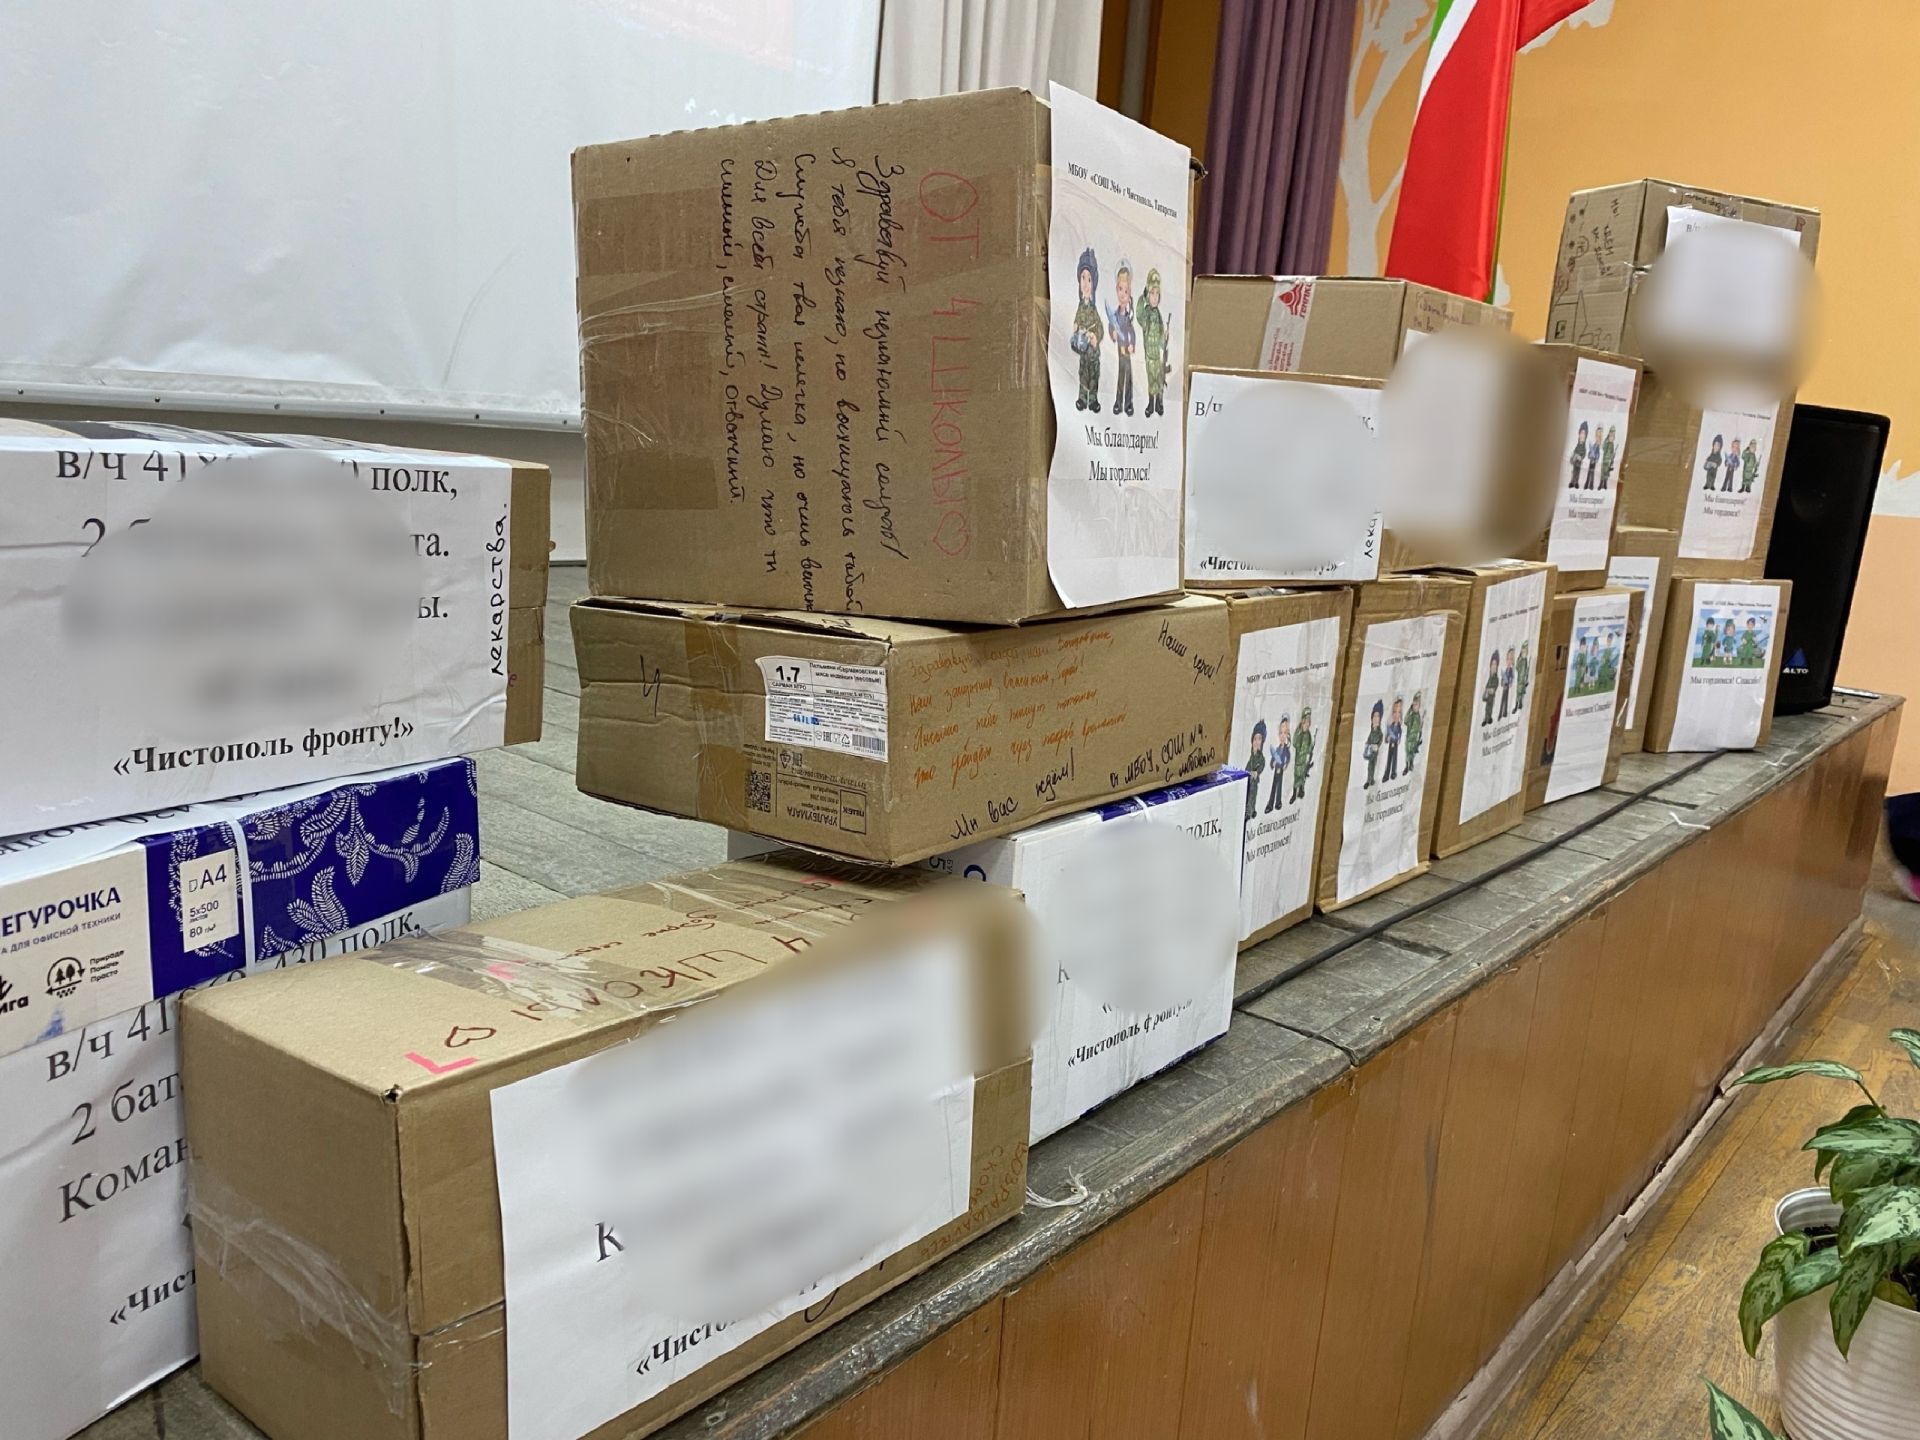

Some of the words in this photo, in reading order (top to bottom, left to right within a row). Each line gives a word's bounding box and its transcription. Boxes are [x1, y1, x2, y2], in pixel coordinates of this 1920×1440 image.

[832, 148, 855, 167] Я
[1068, 162, 1088, 180] МБОУ
[753, 160, 777, 203] Для
[832, 184, 850, 235] тебя
[919, 173, 979, 259] ОТ
[932, 298, 982, 316] 4
[747, 384, 783, 468] Думаю
[930, 336, 971, 504] ШКОЛЫ
[1085, 425, 1103, 446] Мы
[1104, 427, 1159, 454] благодарим!
[371, 466, 458, 500] полк,
[793, 456, 807, 479] но
[1089, 460, 1107, 481] Мы
[1109, 462, 1151, 487] гордимся!
[1364, 510, 1381, 558] лека
[486, 503, 507, 676] лекарства.
[776, 665, 800, 682] 1.7
[113, 738, 294, 777] «Чистополь
[301, 718, 415, 756] фронту!»
[787, 806, 837, 826] УРАЛБУМАГА
[1257, 808, 1300, 836] благодарим!
[1257, 831, 1292, 858] гордимся!
[200, 864, 227, 890] A4
[1, 887, 121, 937] ЕГУРОЧКА
[10, 938, 30, 953] ДЛЯ
[33, 924, 79, 946] ОФИСНОЙ
[81, 912, 121, 931] ТЕХНИКИ
[189, 926, 203, 938] 80
[339, 911, 422, 953] полк,
[0, 995, 29, 1015] ига
[1067, 1021, 1141, 1068] «Чистополь
[71, 1102, 96, 1144] 2
[110, 1072, 180, 1123] бат
[57, 1136, 190, 1223] Коман
[109, 1267, 196, 1325] «Чист
